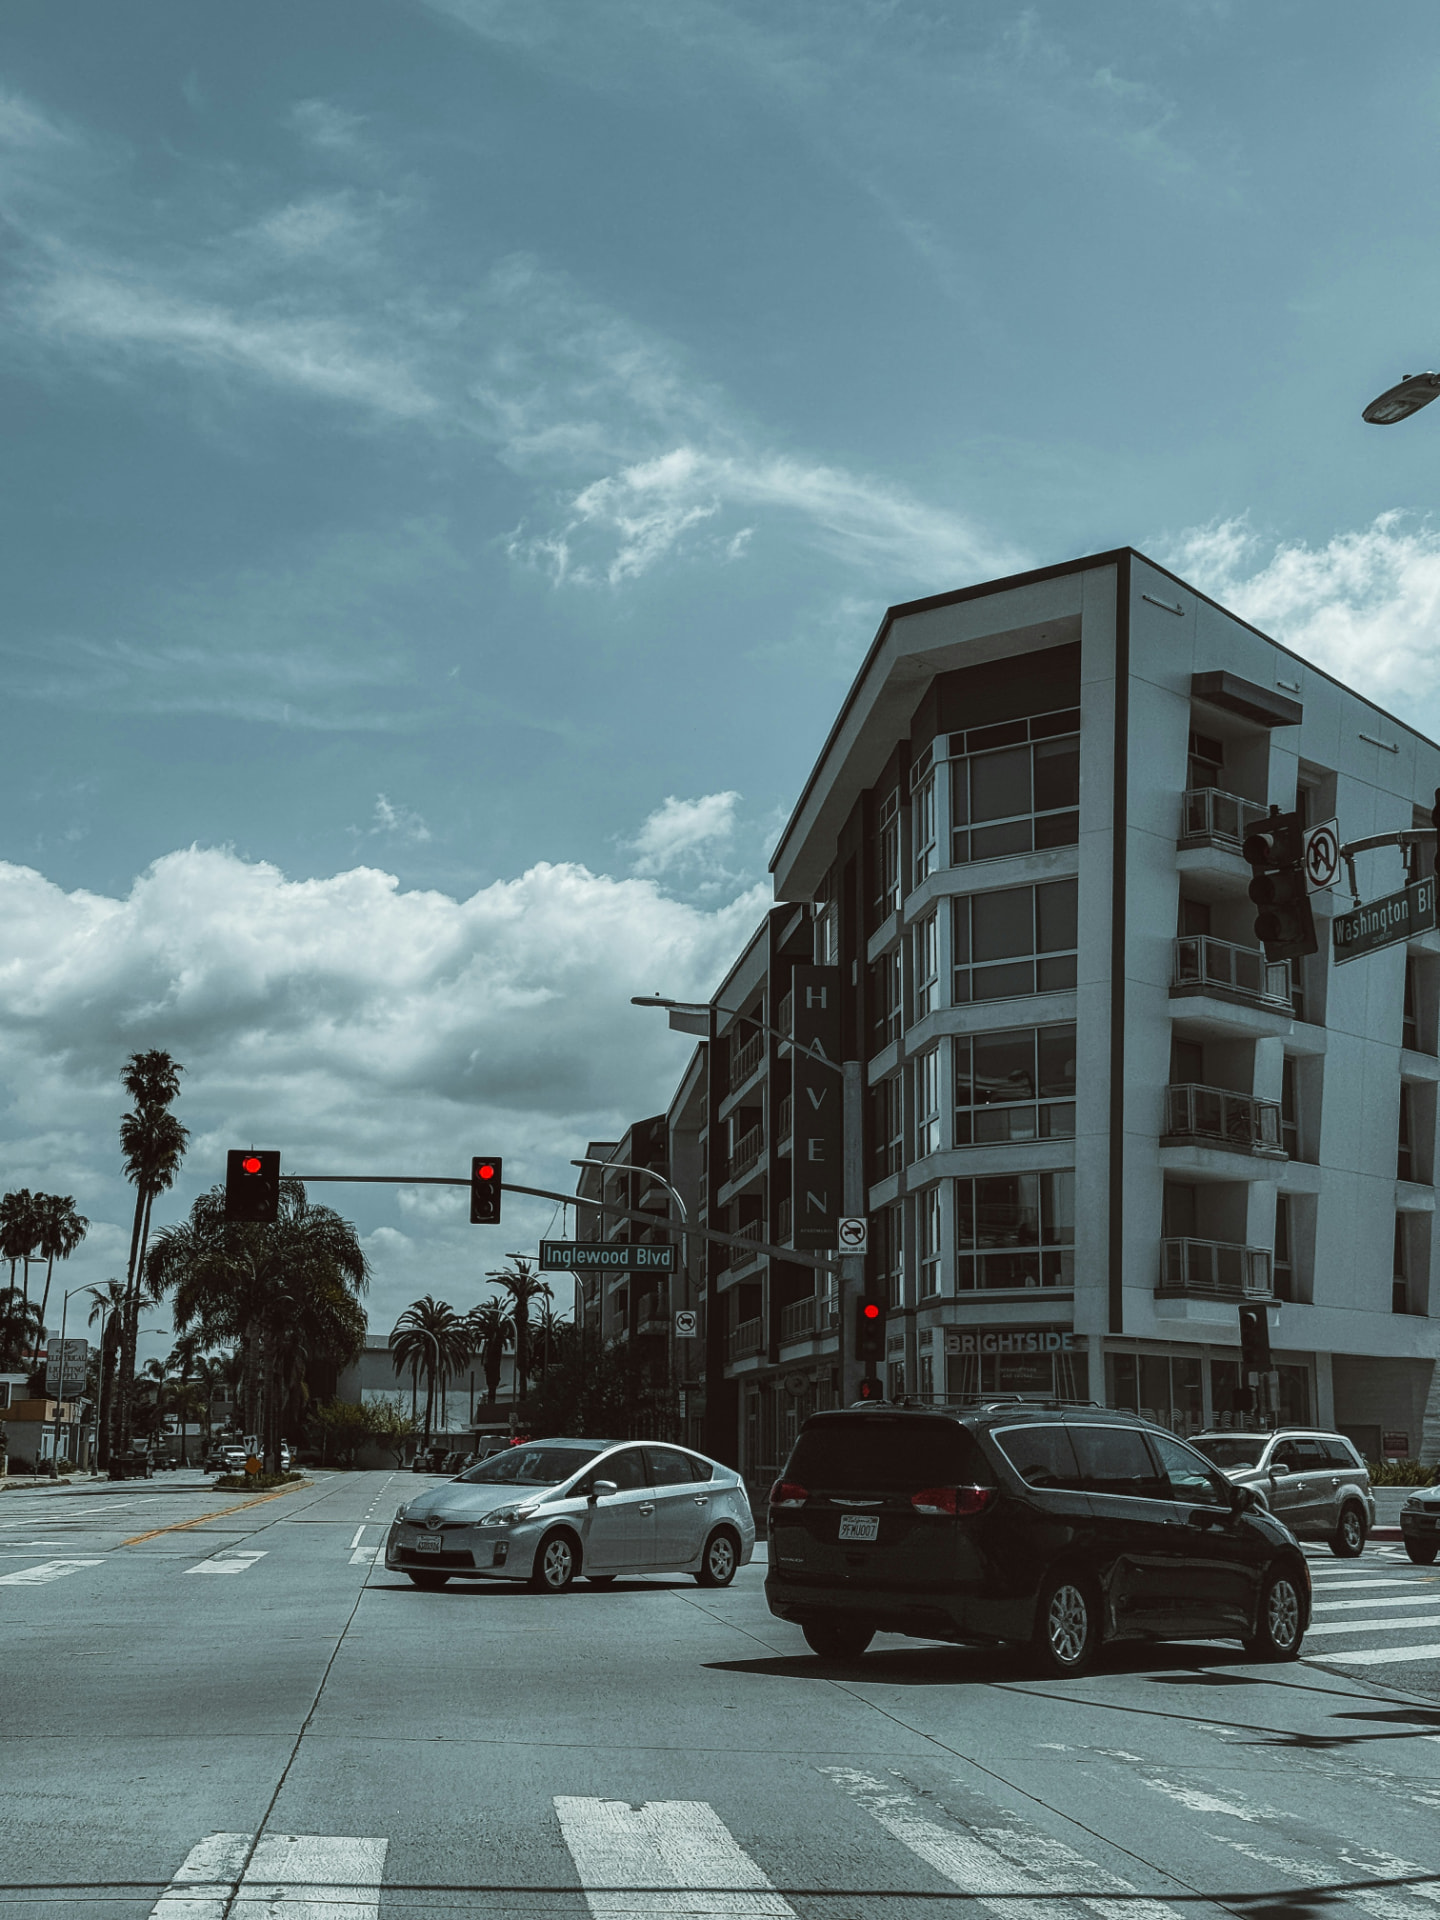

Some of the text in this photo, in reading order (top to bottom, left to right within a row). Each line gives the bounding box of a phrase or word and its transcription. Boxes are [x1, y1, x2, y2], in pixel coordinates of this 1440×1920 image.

[1335, 884, 1431, 945] Washington Bl
[805, 986, 828, 1214] HAVEN
[547, 1246, 670, 1268] Inglewood Blvd
[946, 1332, 1073, 1352] BRIGHTSIDE
